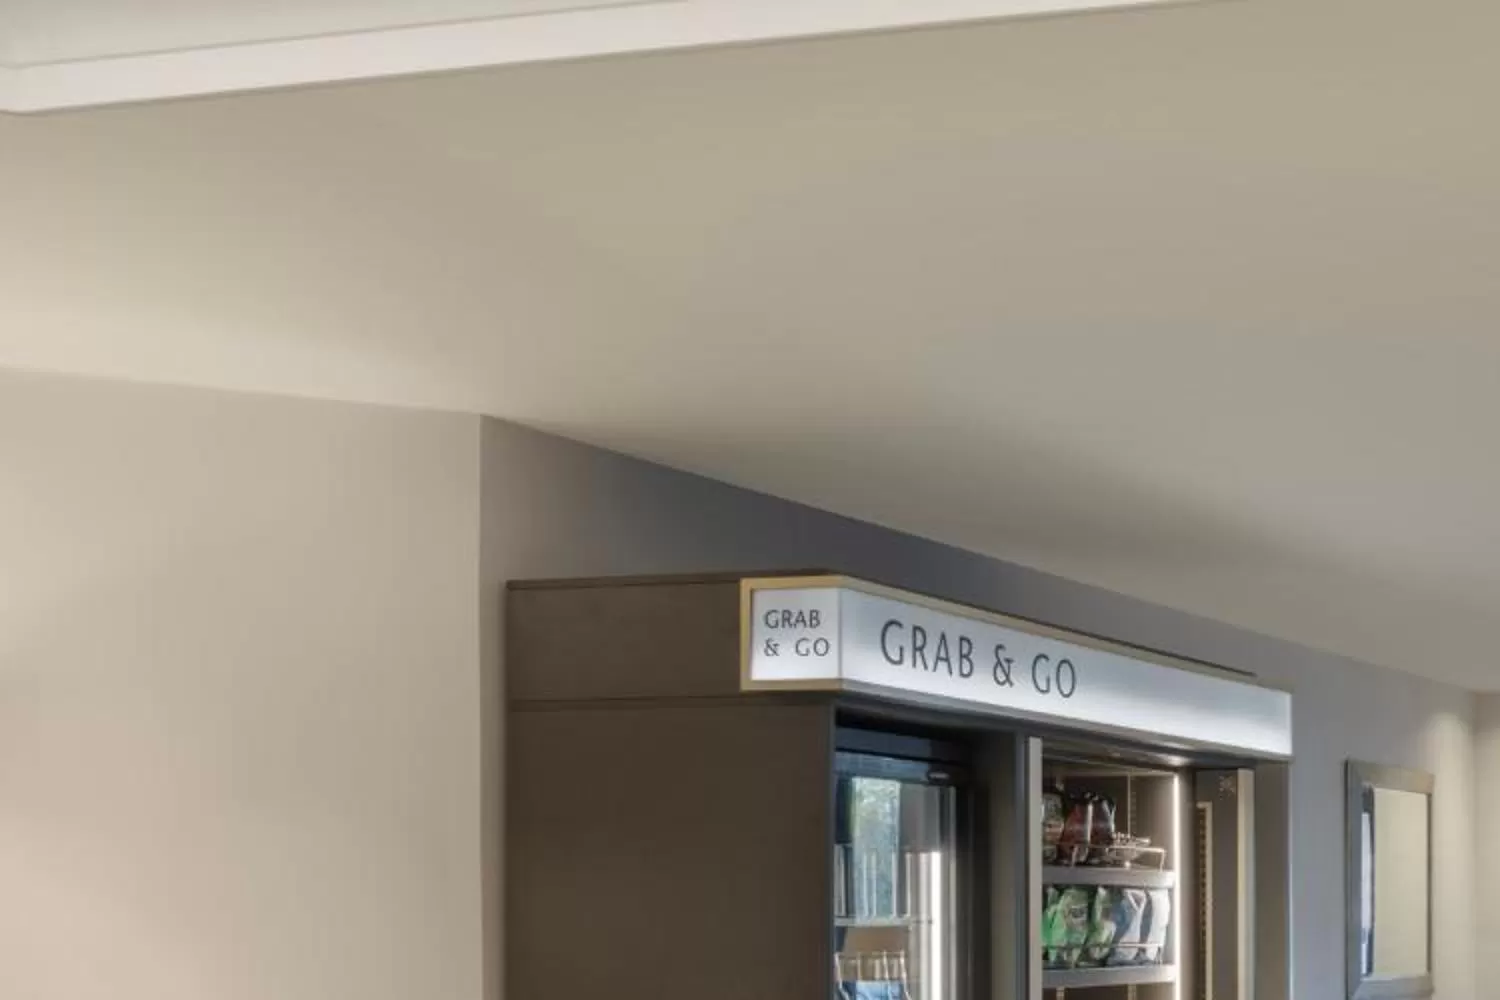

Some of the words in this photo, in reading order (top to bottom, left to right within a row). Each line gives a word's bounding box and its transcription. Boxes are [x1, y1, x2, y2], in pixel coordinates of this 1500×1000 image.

[764, 608, 821, 629] GRAB
[764, 637, 781, 657] &
[795, 637, 829, 657] GO
[881, 619, 974, 679] GRAB
[993, 643, 1014, 688] &
[1031, 653, 1076, 698] GO
